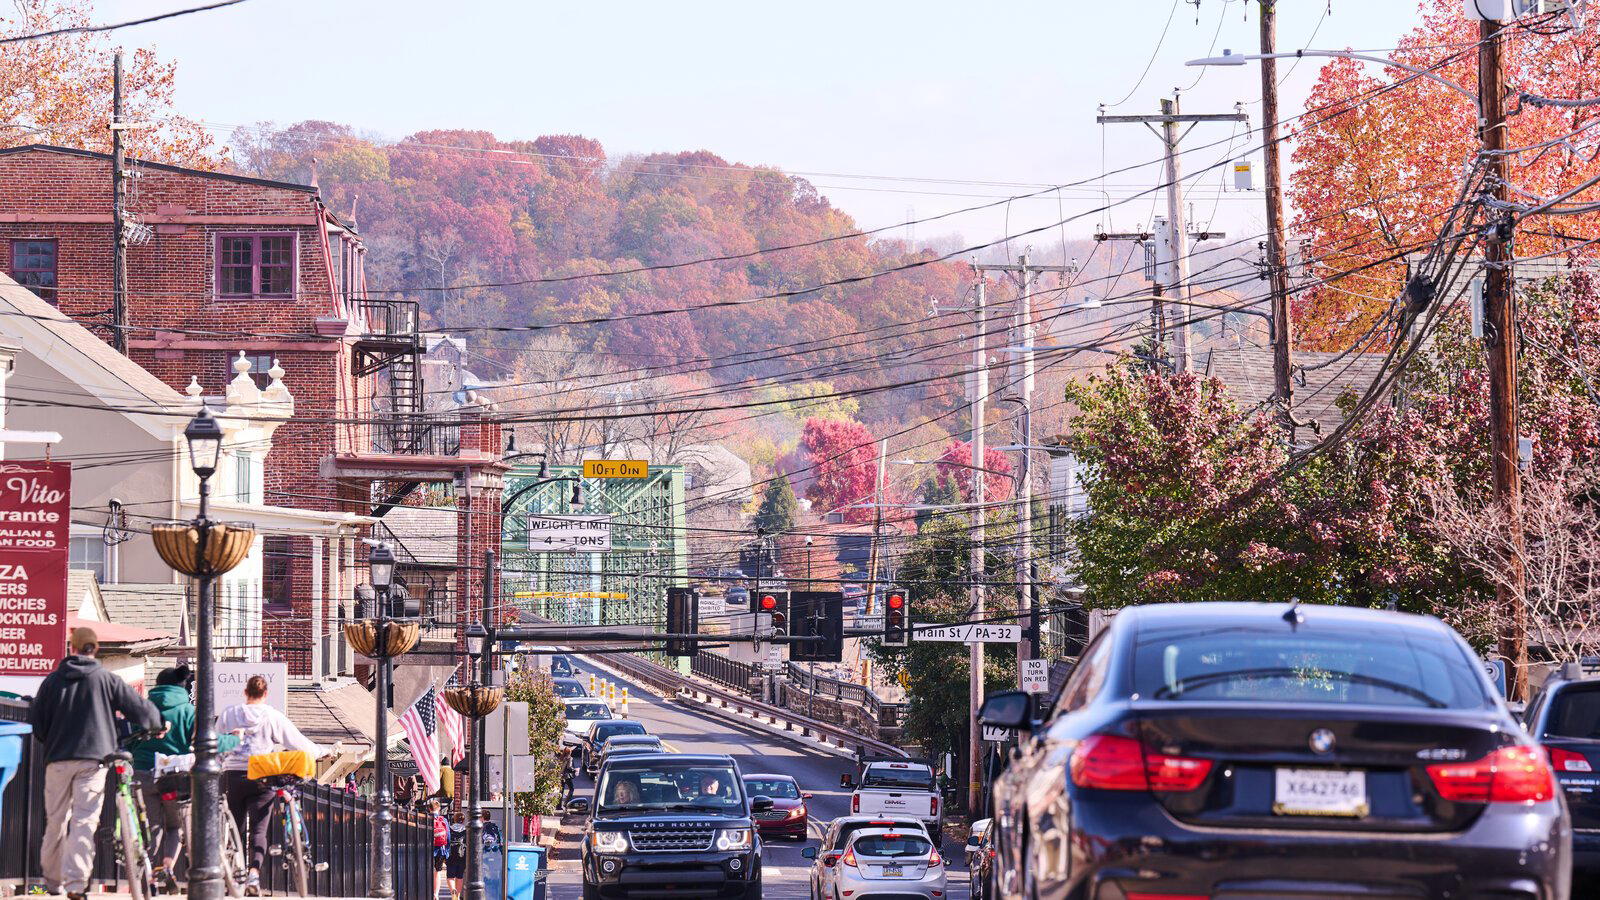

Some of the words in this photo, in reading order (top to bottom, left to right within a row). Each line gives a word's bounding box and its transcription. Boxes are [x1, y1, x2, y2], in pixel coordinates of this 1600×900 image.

[6, 477, 65, 504] Vito
[532, 520, 575, 530] WEIGHT
[0, 529, 42, 538] ALIAN
[45, 530, 55, 538] &
[544, 536, 553, 545] 4
[573, 536, 605, 545] TONS
[917, 628, 945, 638] Main
[949, 628, 961, 638] St
[975, 628, 1012, 639] PA-32
[19, 643, 43, 655] BAR
[0, 657, 56, 670] DELIVERY
[217, 673, 275, 683] GALLY
